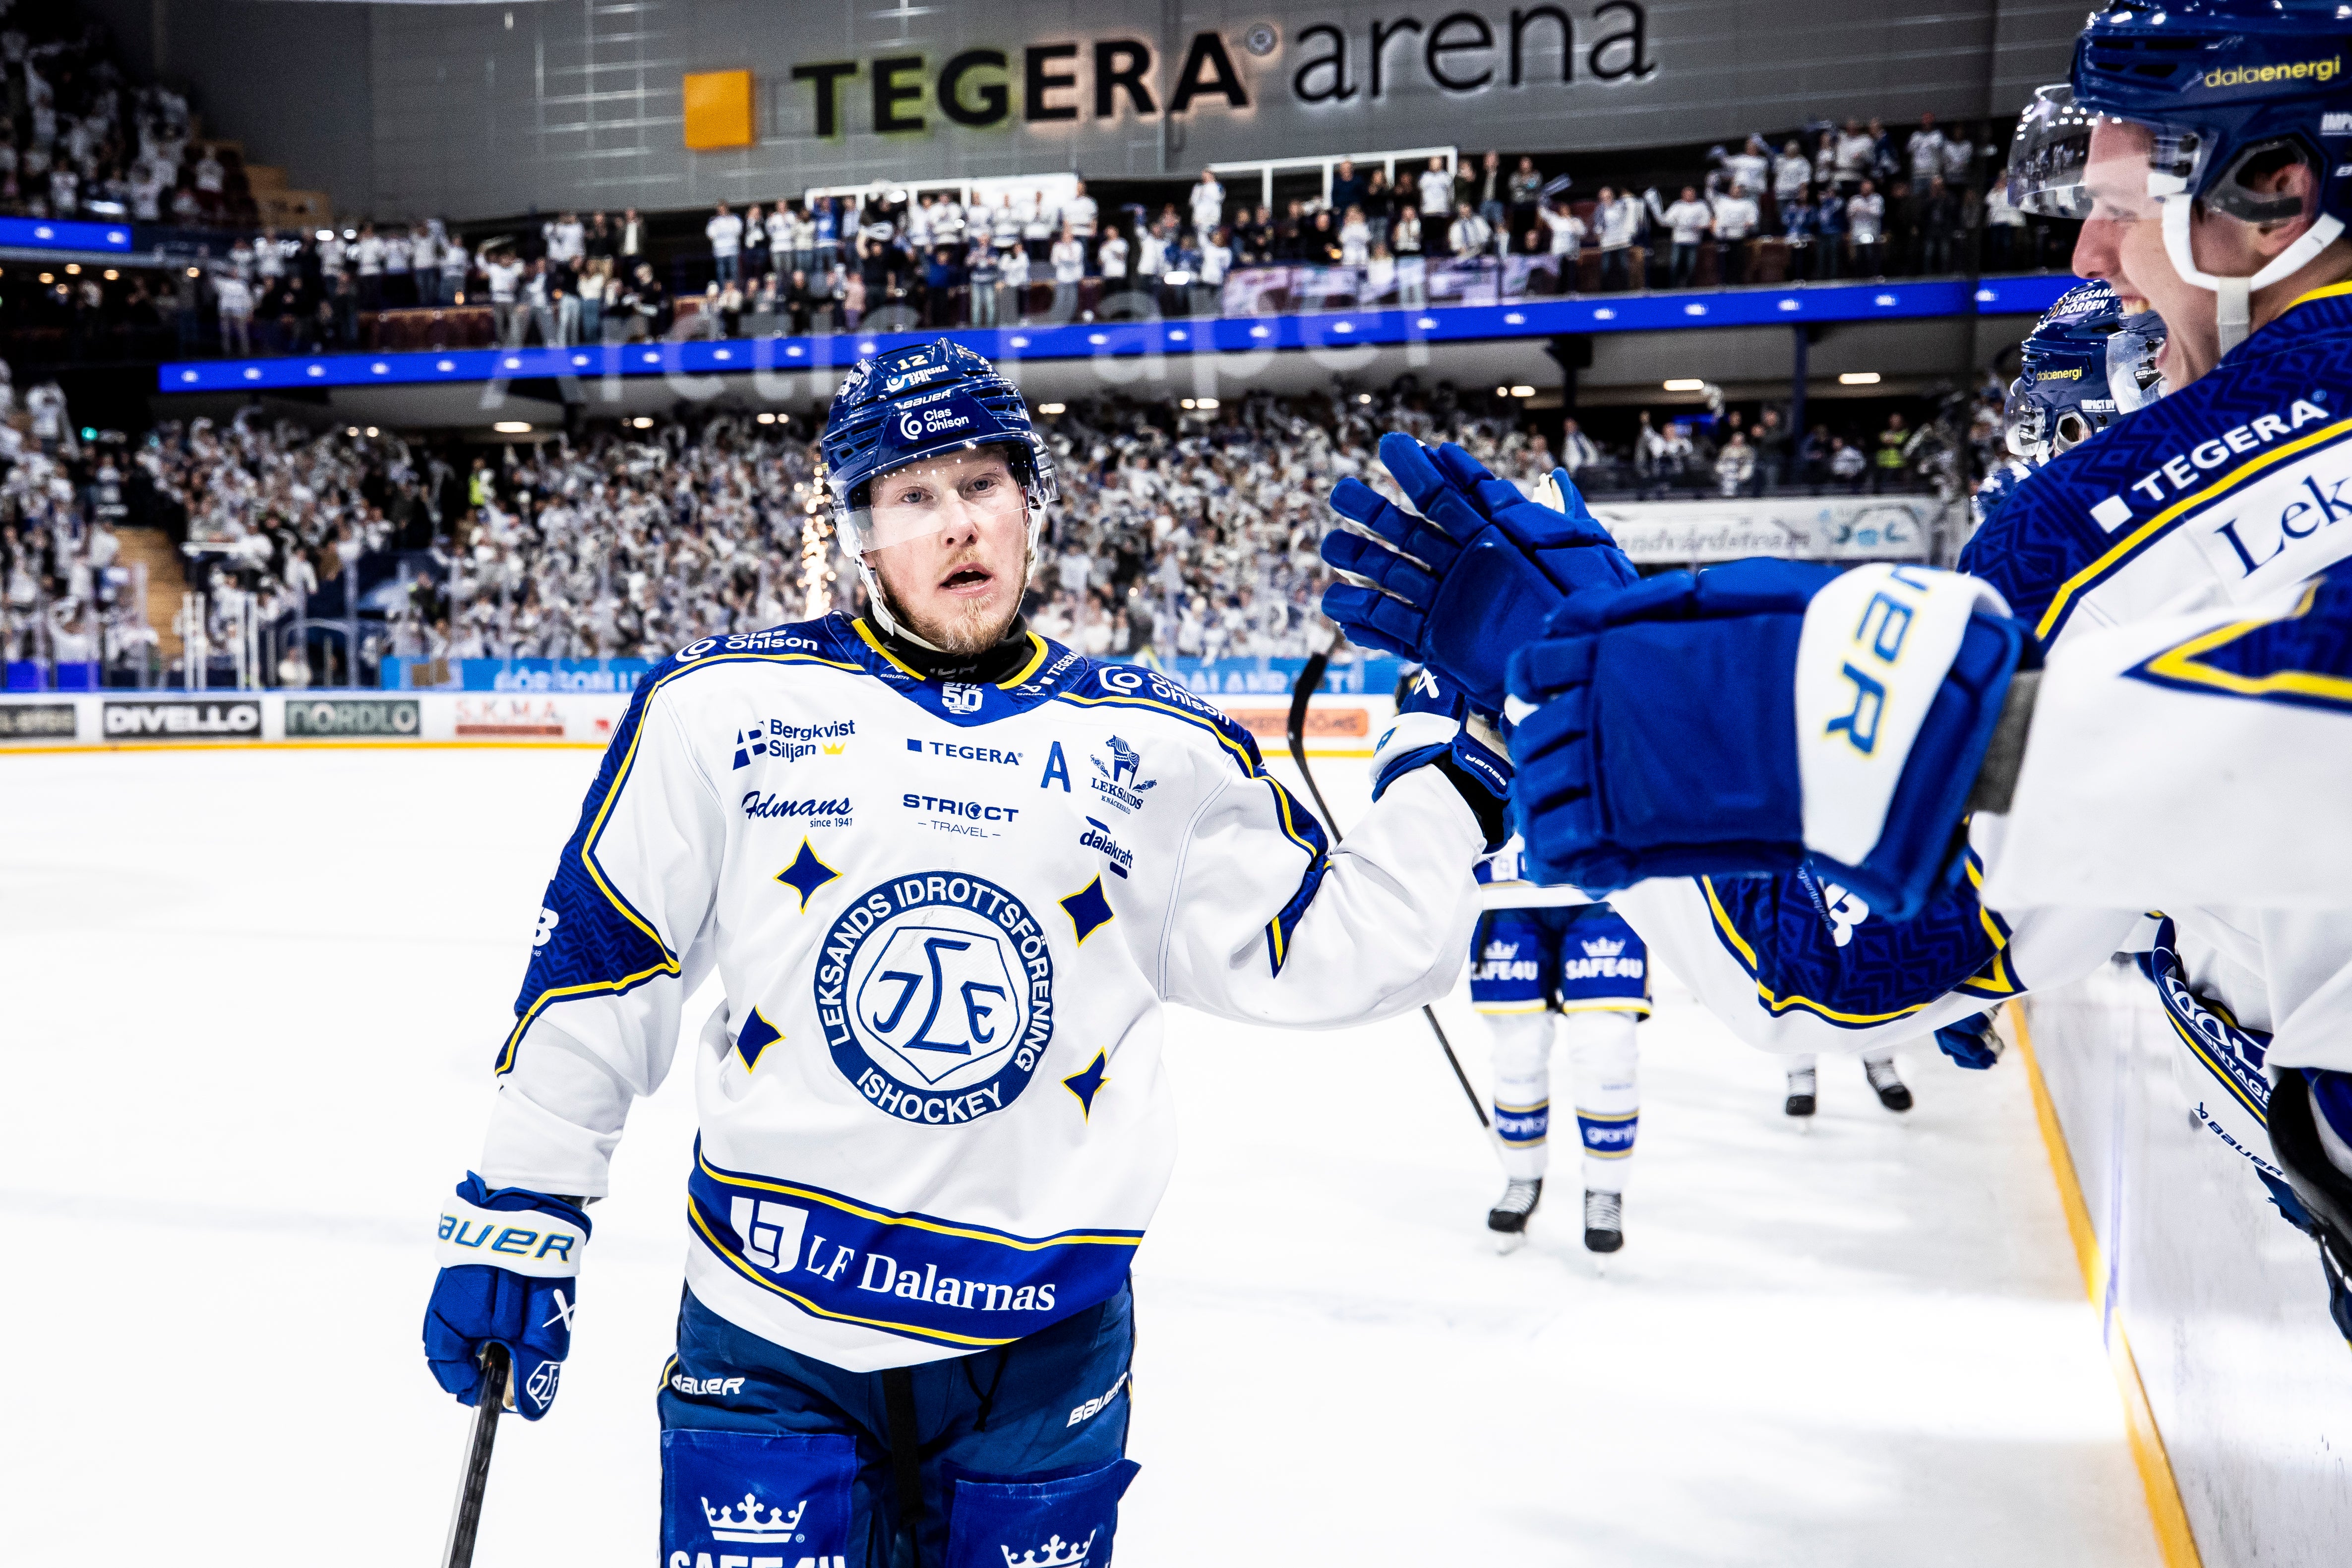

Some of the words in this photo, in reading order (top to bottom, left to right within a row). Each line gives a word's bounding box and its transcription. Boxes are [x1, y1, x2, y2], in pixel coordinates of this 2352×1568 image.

[792, 33, 1248, 137] TEGERA
[1293, 0, 1655, 103] arena
[2205, 54, 2341, 88] dalaenergi
[898, 355, 928, 370] 12
[909, 365, 949, 380] SVENSKA
[2037, 366, 2082, 381] dalaenergi
[909, 375, 931, 386] SPEL
[903, 389, 951, 409] BAUER
[924, 409, 952, 421] Clas
[926, 416, 969, 432] Ohlson
[2214, 474, 2352, 579] Lek
[725, 637, 817, 651] Ohlson
[942, 686, 983, 712] 50
[1152, 682, 1230, 725] Ohlson
[106, 706, 259, 734] DIVELLO
[770, 719, 855, 741] Bergkvist
[769, 740, 816, 762] Siljan
[1040, 741, 1071, 792] A
[1465, 754, 1507, 786] BAUER
[1091, 777, 1144, 809] LEKSANDS
[810, 818, 831, 827] since
[835, 817, 852, 827] 1941
[931, 820, 988, 838] TRAVEL
[1080, 830, 1133, 868] dalakraft
[819, 893, 892, 1046] LEKSANDS
[894, 876, 1050, 1072] IDROTTSFÖRENING
[1565, 958, 1643, 980] SAFE4U
[856, 1067, 1002, 1123] ISHOCKEY
[2207, 1121, 2285, 1177] BAUER
[804, 1235, 855, 1282] LF
[858, 1252, 1056, 1312] Dalarnas
